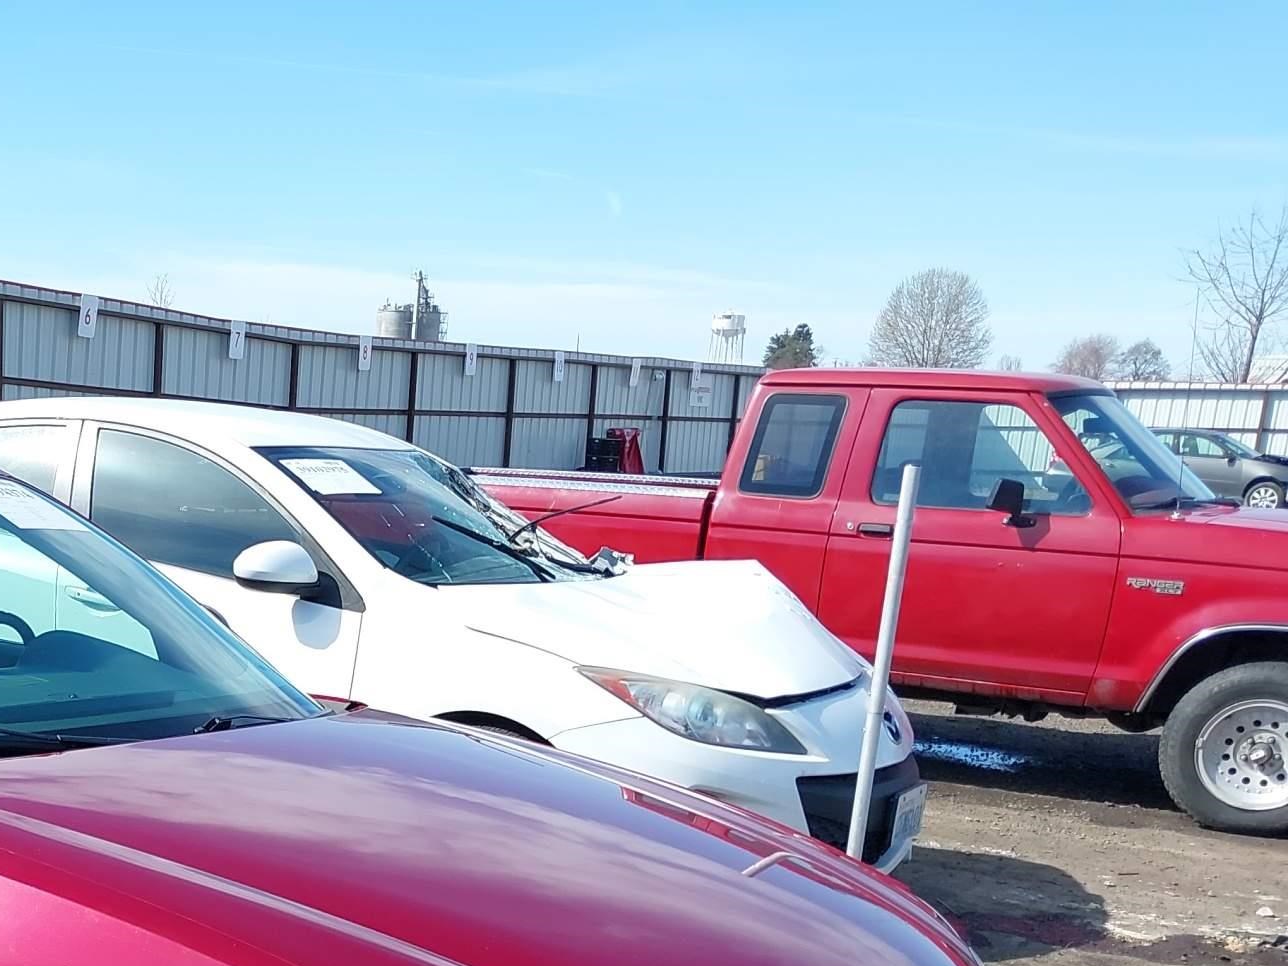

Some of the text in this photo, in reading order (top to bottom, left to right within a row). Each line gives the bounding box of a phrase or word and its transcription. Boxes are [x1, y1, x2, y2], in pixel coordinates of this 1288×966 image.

[84, 308, 91, 325] 6
[235, 331, 241, 348] 7
[362, 344, 368, 361] 8
[469, 352, 474, 366] 9
[1126, 577, 1185, 590] RANGER
